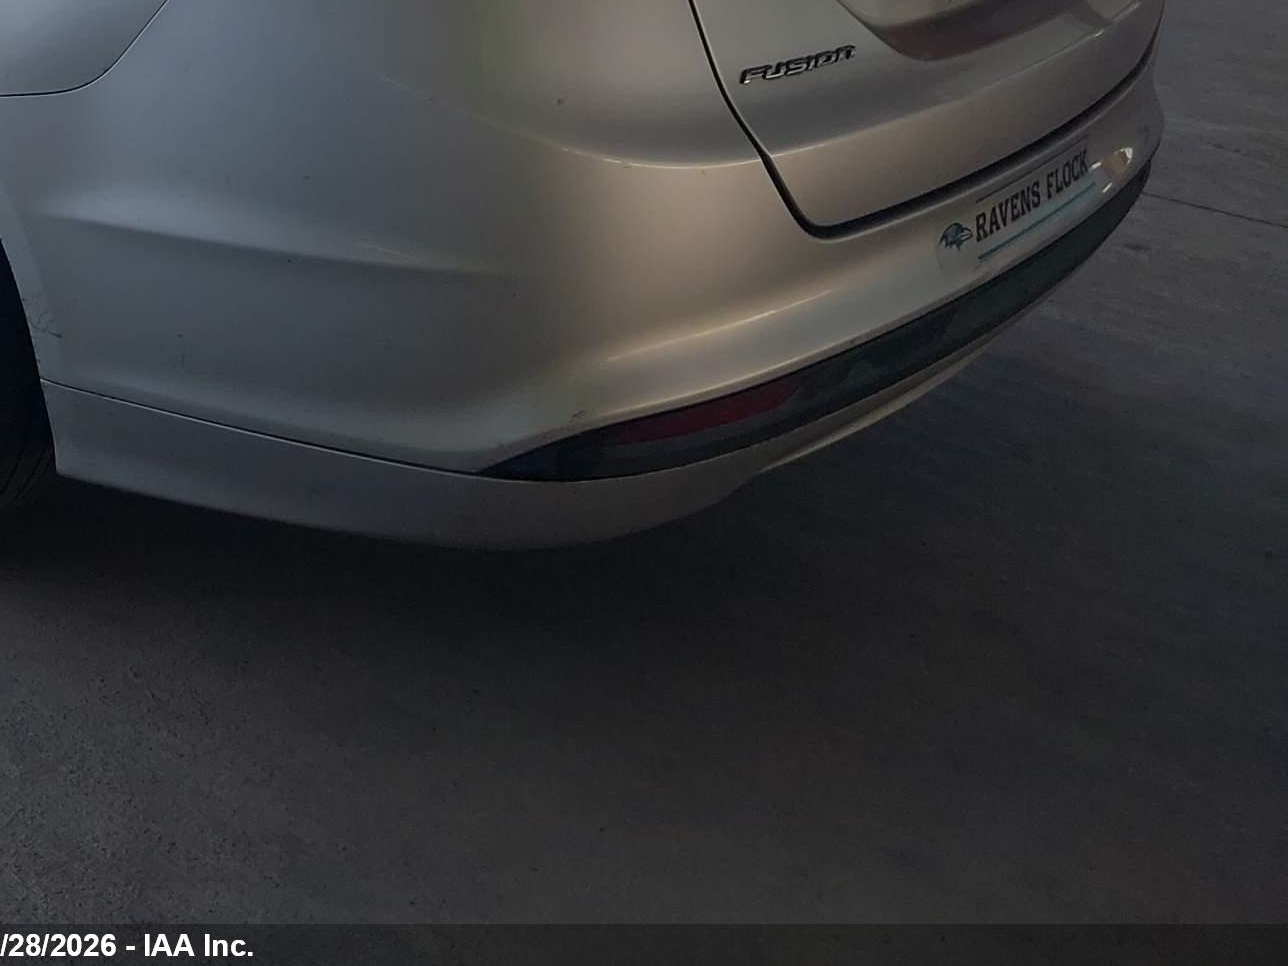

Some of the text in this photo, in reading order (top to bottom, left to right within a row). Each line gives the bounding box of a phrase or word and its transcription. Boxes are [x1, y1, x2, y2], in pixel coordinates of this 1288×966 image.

[739, 44, 856, 85] FUSION
[975, 148, 1089, 242] RAVENS FLOCK
